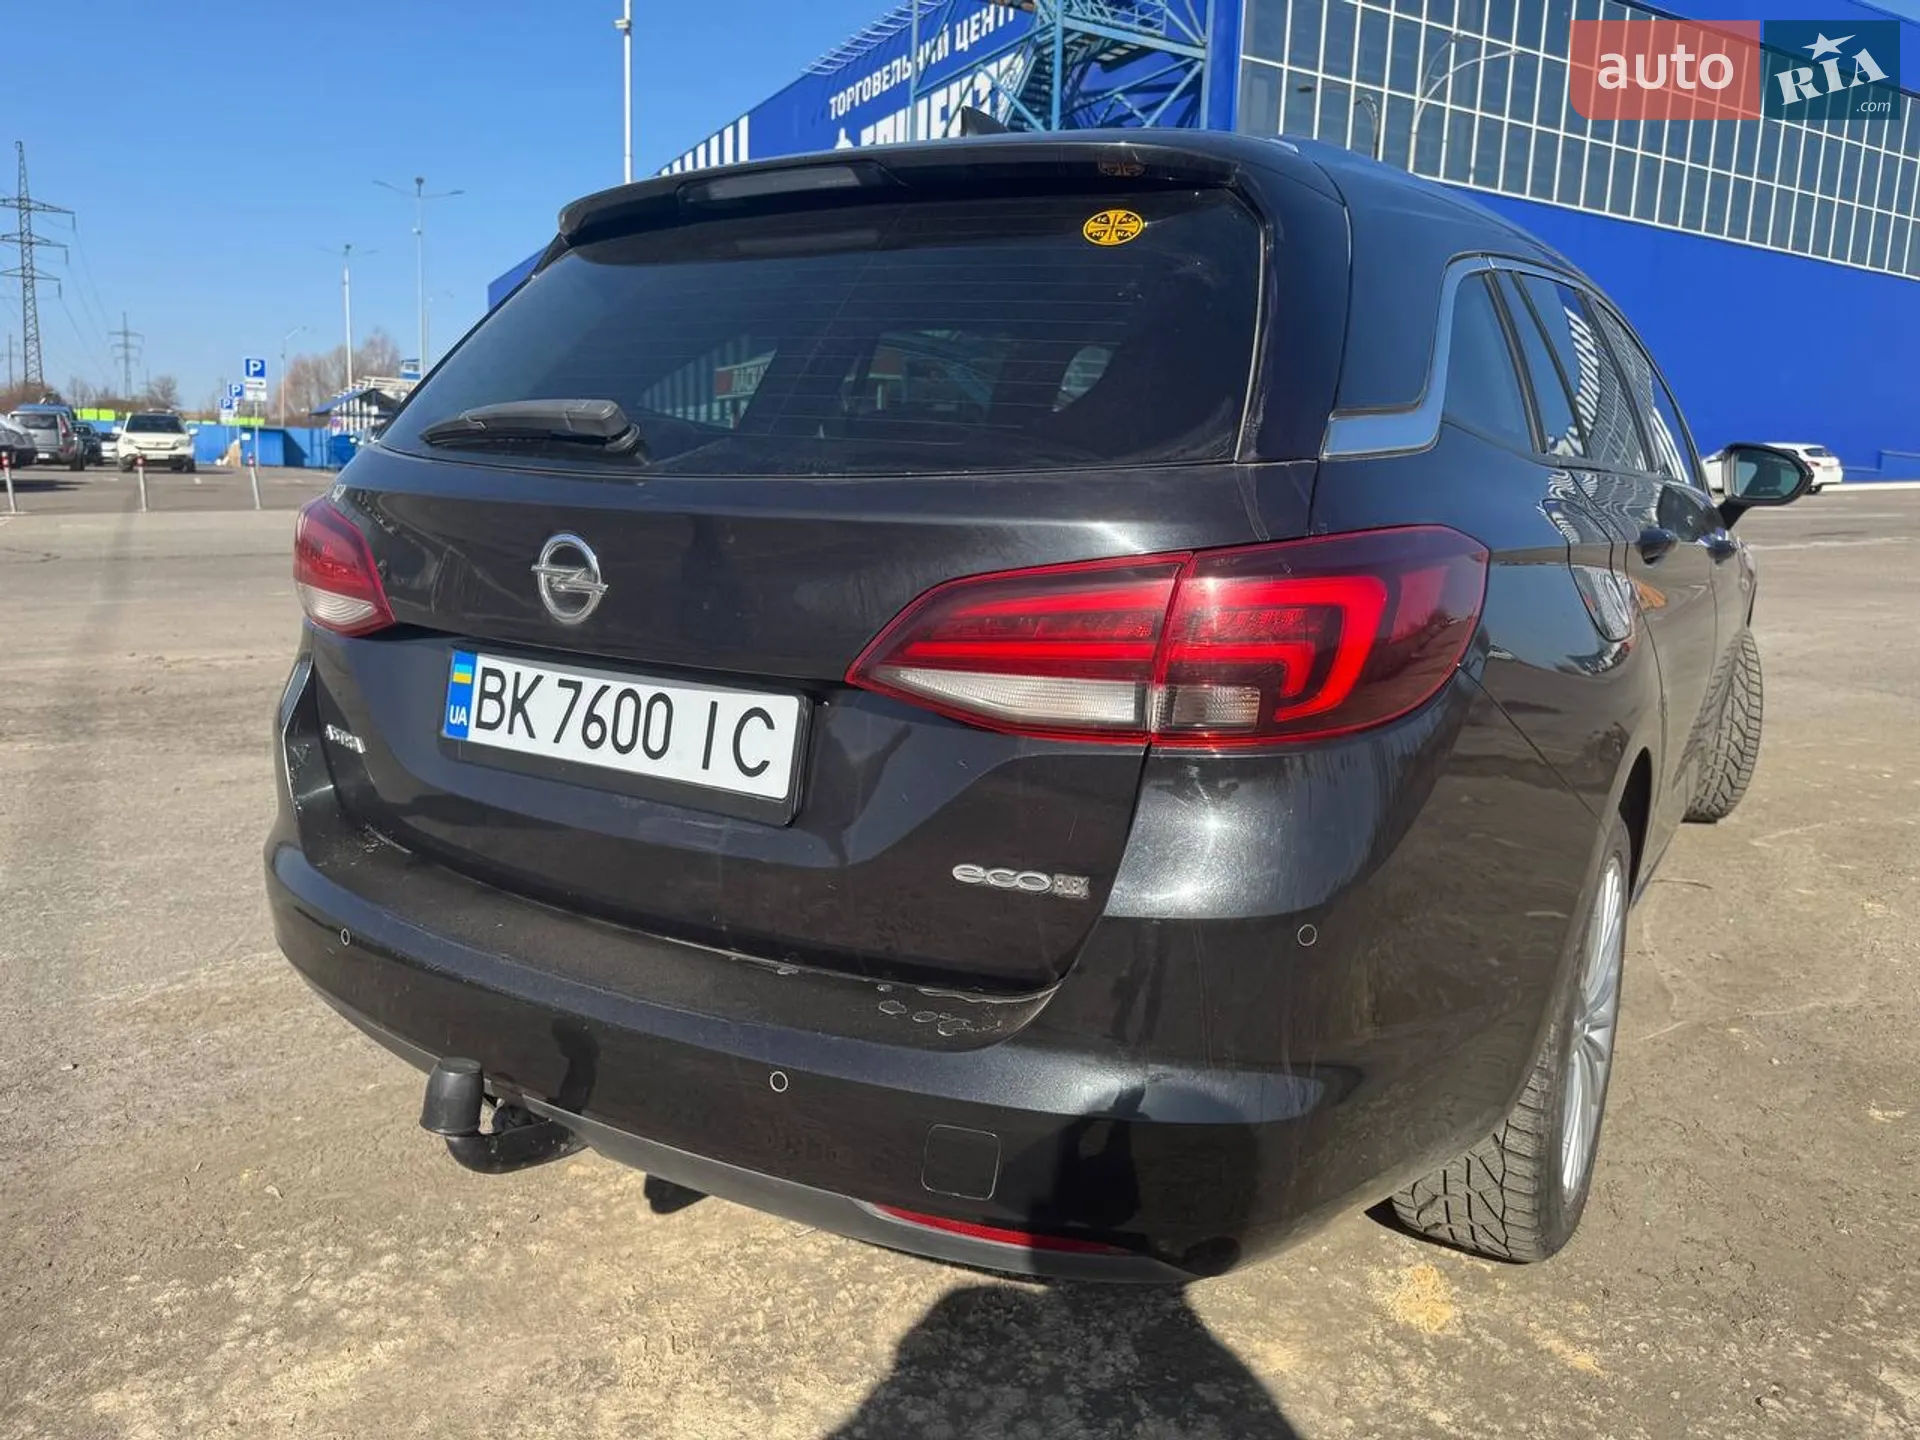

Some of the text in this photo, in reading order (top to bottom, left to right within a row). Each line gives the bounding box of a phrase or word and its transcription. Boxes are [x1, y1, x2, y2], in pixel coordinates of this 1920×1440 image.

[829, 24, 949, 120] ТОРГОВЕЛЬНИЙ
[250, 360, 262, 377] P
[232, 384, 241, 397] P
[449, 704, 468, 726] UA
[475, 667, 776, 778] BK 7600 IC
